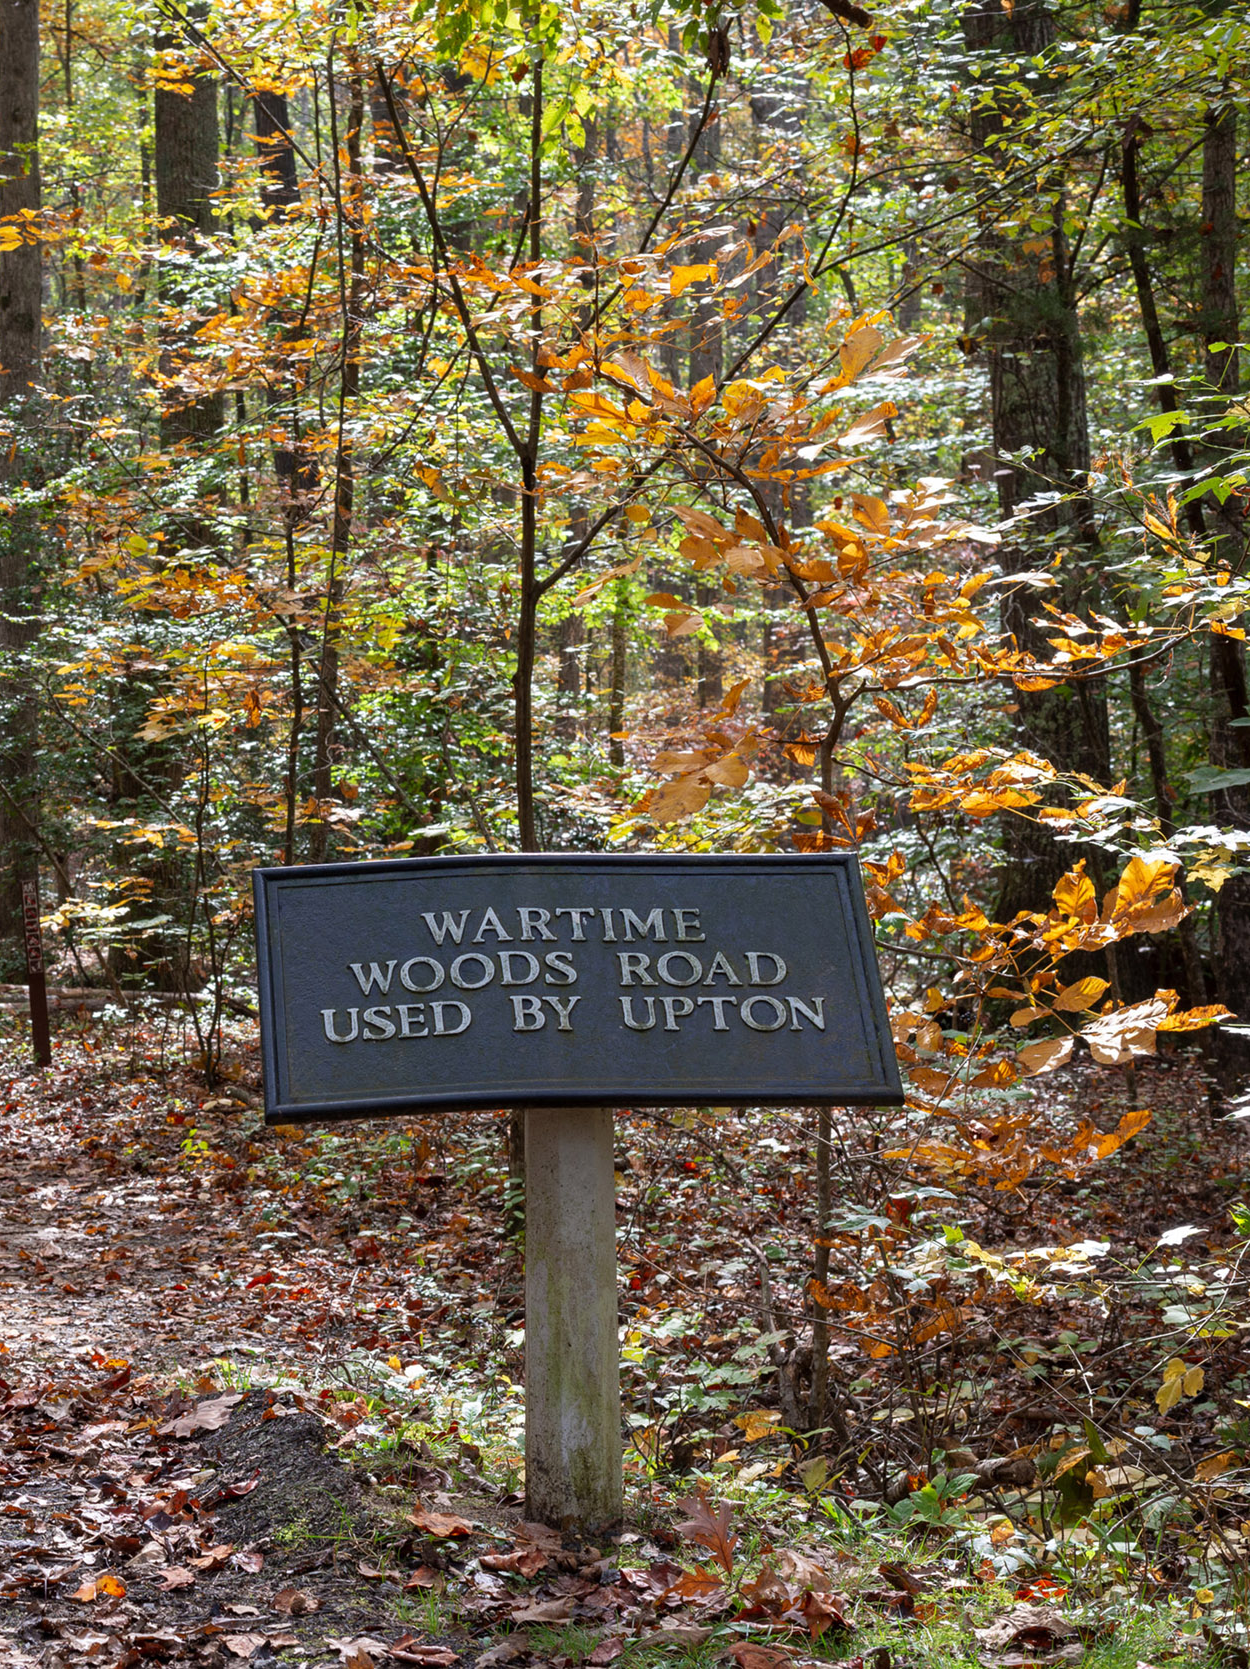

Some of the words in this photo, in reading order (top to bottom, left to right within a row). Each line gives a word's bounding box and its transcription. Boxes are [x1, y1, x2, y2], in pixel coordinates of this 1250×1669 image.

[420, 906, 707, 946] WARTIME
[348, 950, 578, 996] WOODS
[616, 950, 787, 988] ROAD
[320, 999, 472, 1044] USED
[509, 994, 581, 1032] BY
[618, 995, 826, 1032] UPTON
